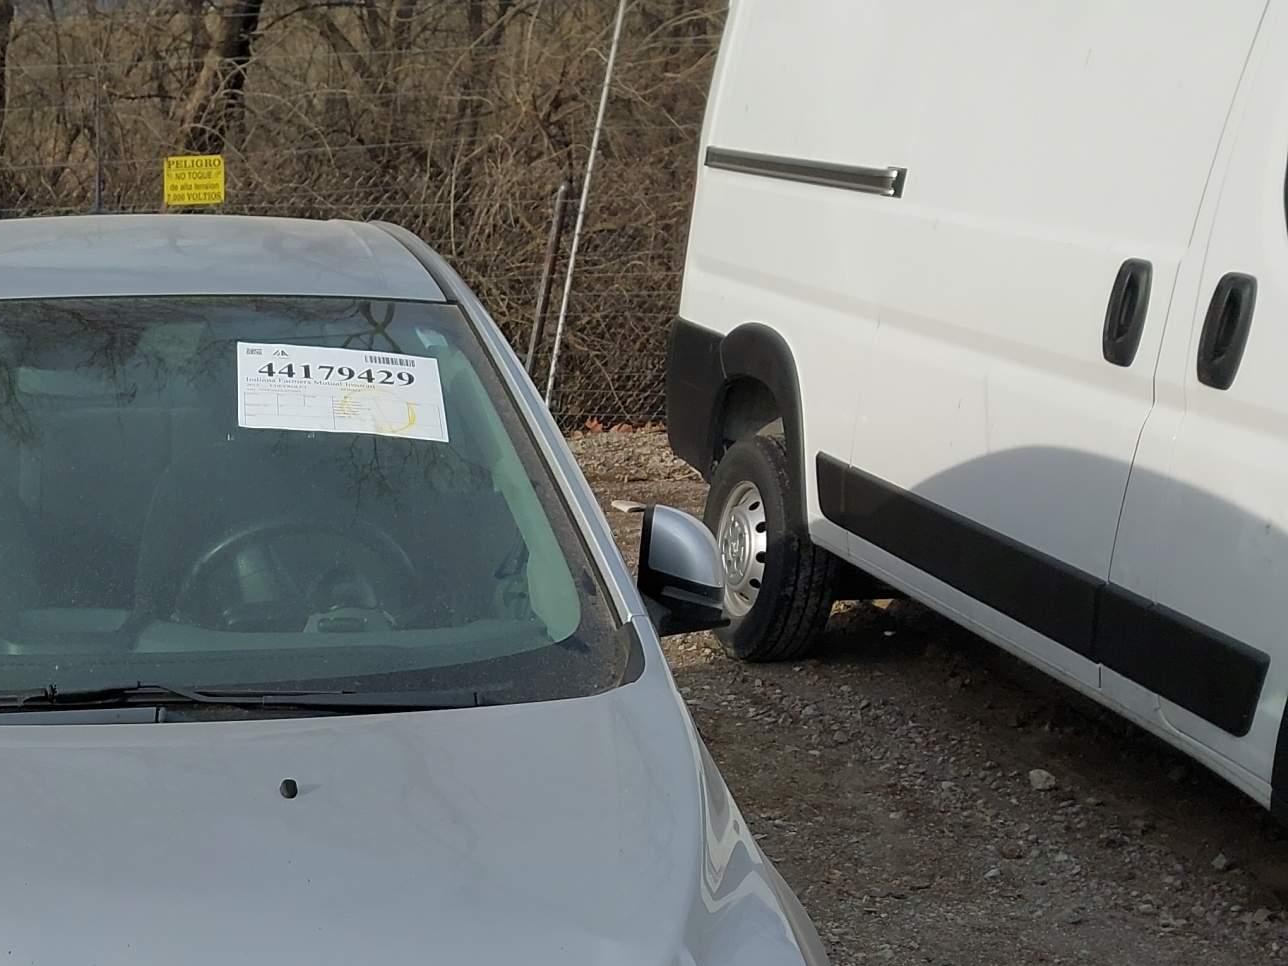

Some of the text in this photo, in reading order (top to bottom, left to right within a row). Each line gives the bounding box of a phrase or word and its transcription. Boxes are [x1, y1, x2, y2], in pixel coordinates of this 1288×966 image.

[168, 158, 221, 168] PELIGRO
[175, 171, 212, 180] NO TOQUE
[187, 192, 222, 201] VOLTIOS
[258, 362, 415, 386] 44179429
